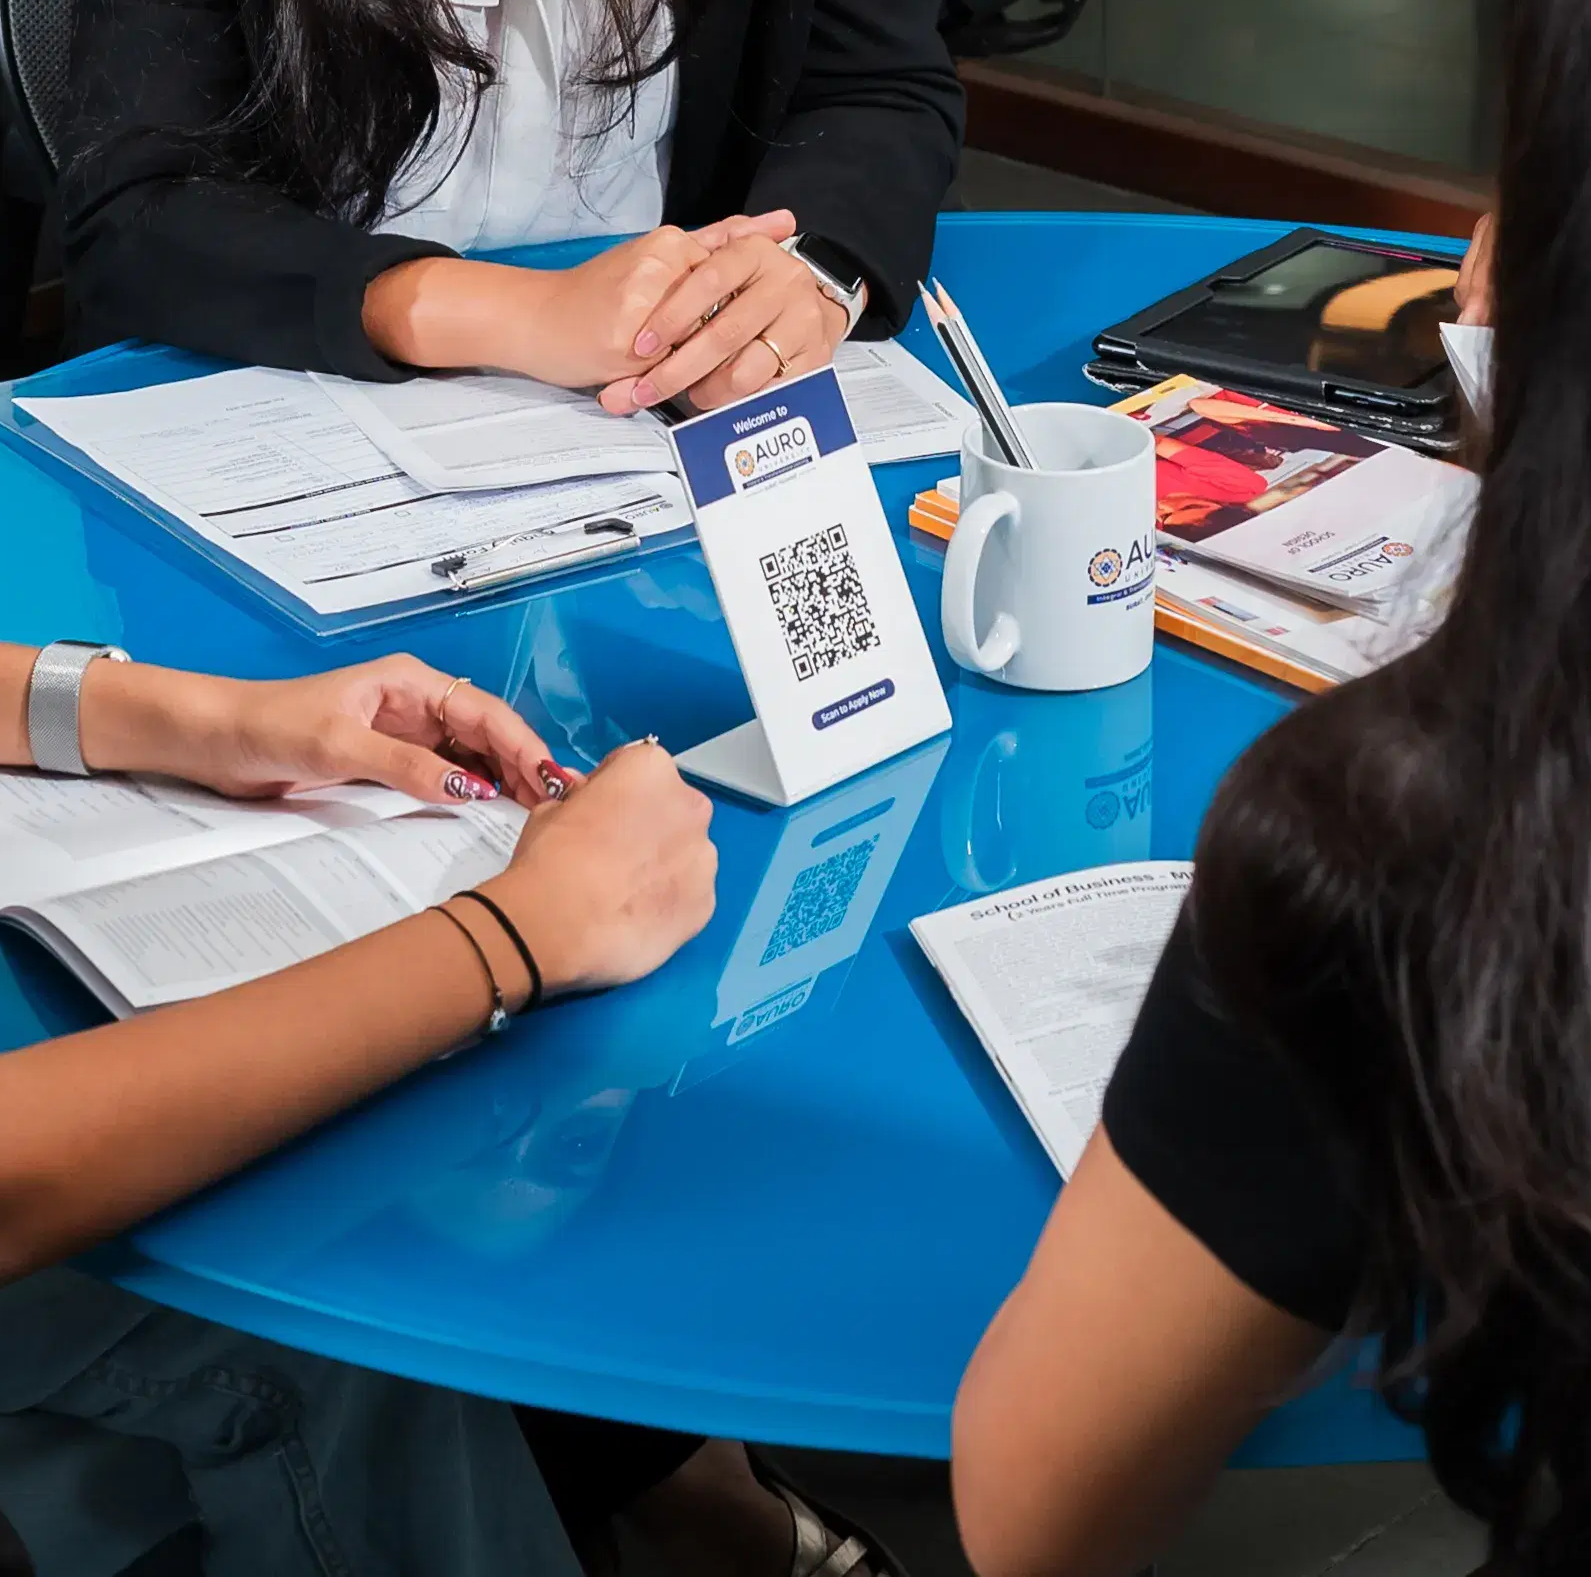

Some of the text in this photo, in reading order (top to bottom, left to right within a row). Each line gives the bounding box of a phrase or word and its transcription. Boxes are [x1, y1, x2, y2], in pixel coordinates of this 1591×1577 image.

[733, 405, 788, 434] Welcome to
[756, 427, 806, 463] AURO
[1126, 527, 1155, 570] AU
[1329, 553, 1393, 581] AURO
[820, 686, 886, 724] Scan to Apply Now
[970, 894, 1039, 921] School
[1043, 887, 1061, 900] of
[1065, 873, 1155, 894] Business
